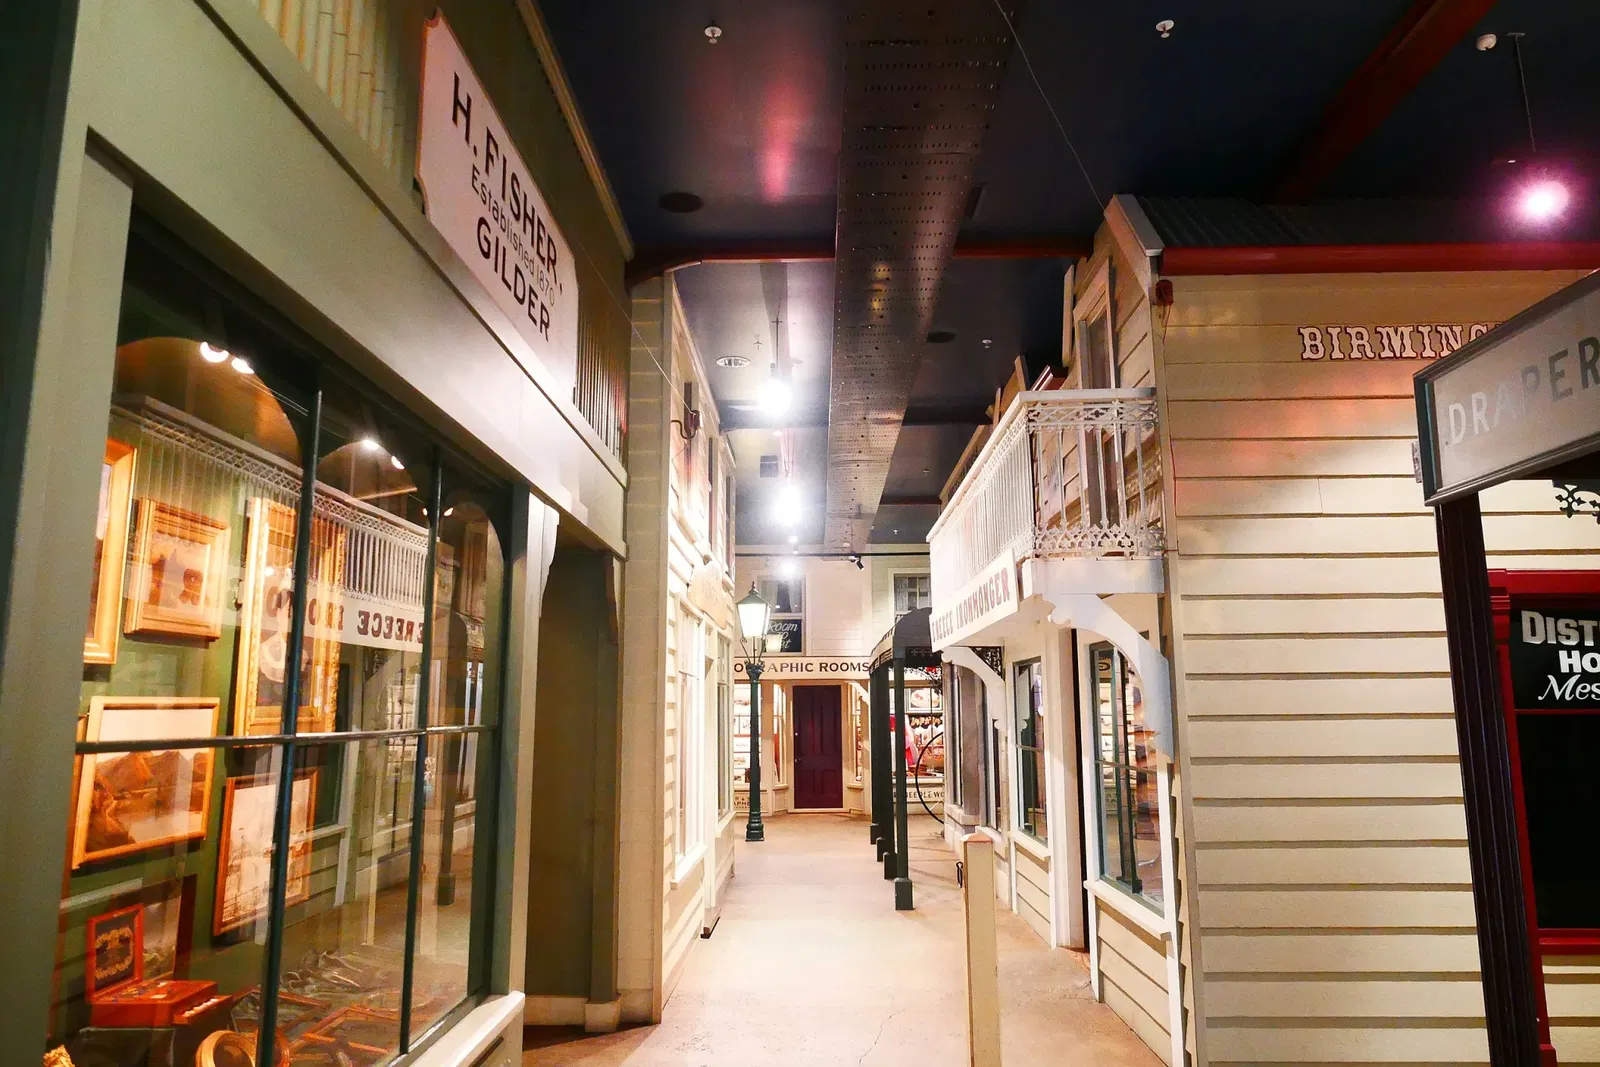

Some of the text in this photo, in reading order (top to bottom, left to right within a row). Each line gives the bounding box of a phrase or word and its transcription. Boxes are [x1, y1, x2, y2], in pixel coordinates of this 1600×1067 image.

[451, 71, 564, 296] H. FISHER,
[471, 163, 536, 276] Established
[476, 216, 551, 343] GILDER
[1298, 323, 1501, 361] BIRMIN
[1448, 336, 1600, 445] DRAPER
[955, 566, 1011, 630] IRONMONGER
[768, 620, 798, 633] Room
[1521, 610, 1600, 646] DIST
[734, 662, 870, 673] OAPHIC ROOMS
[1538, 674, 1600, 701] Mes
